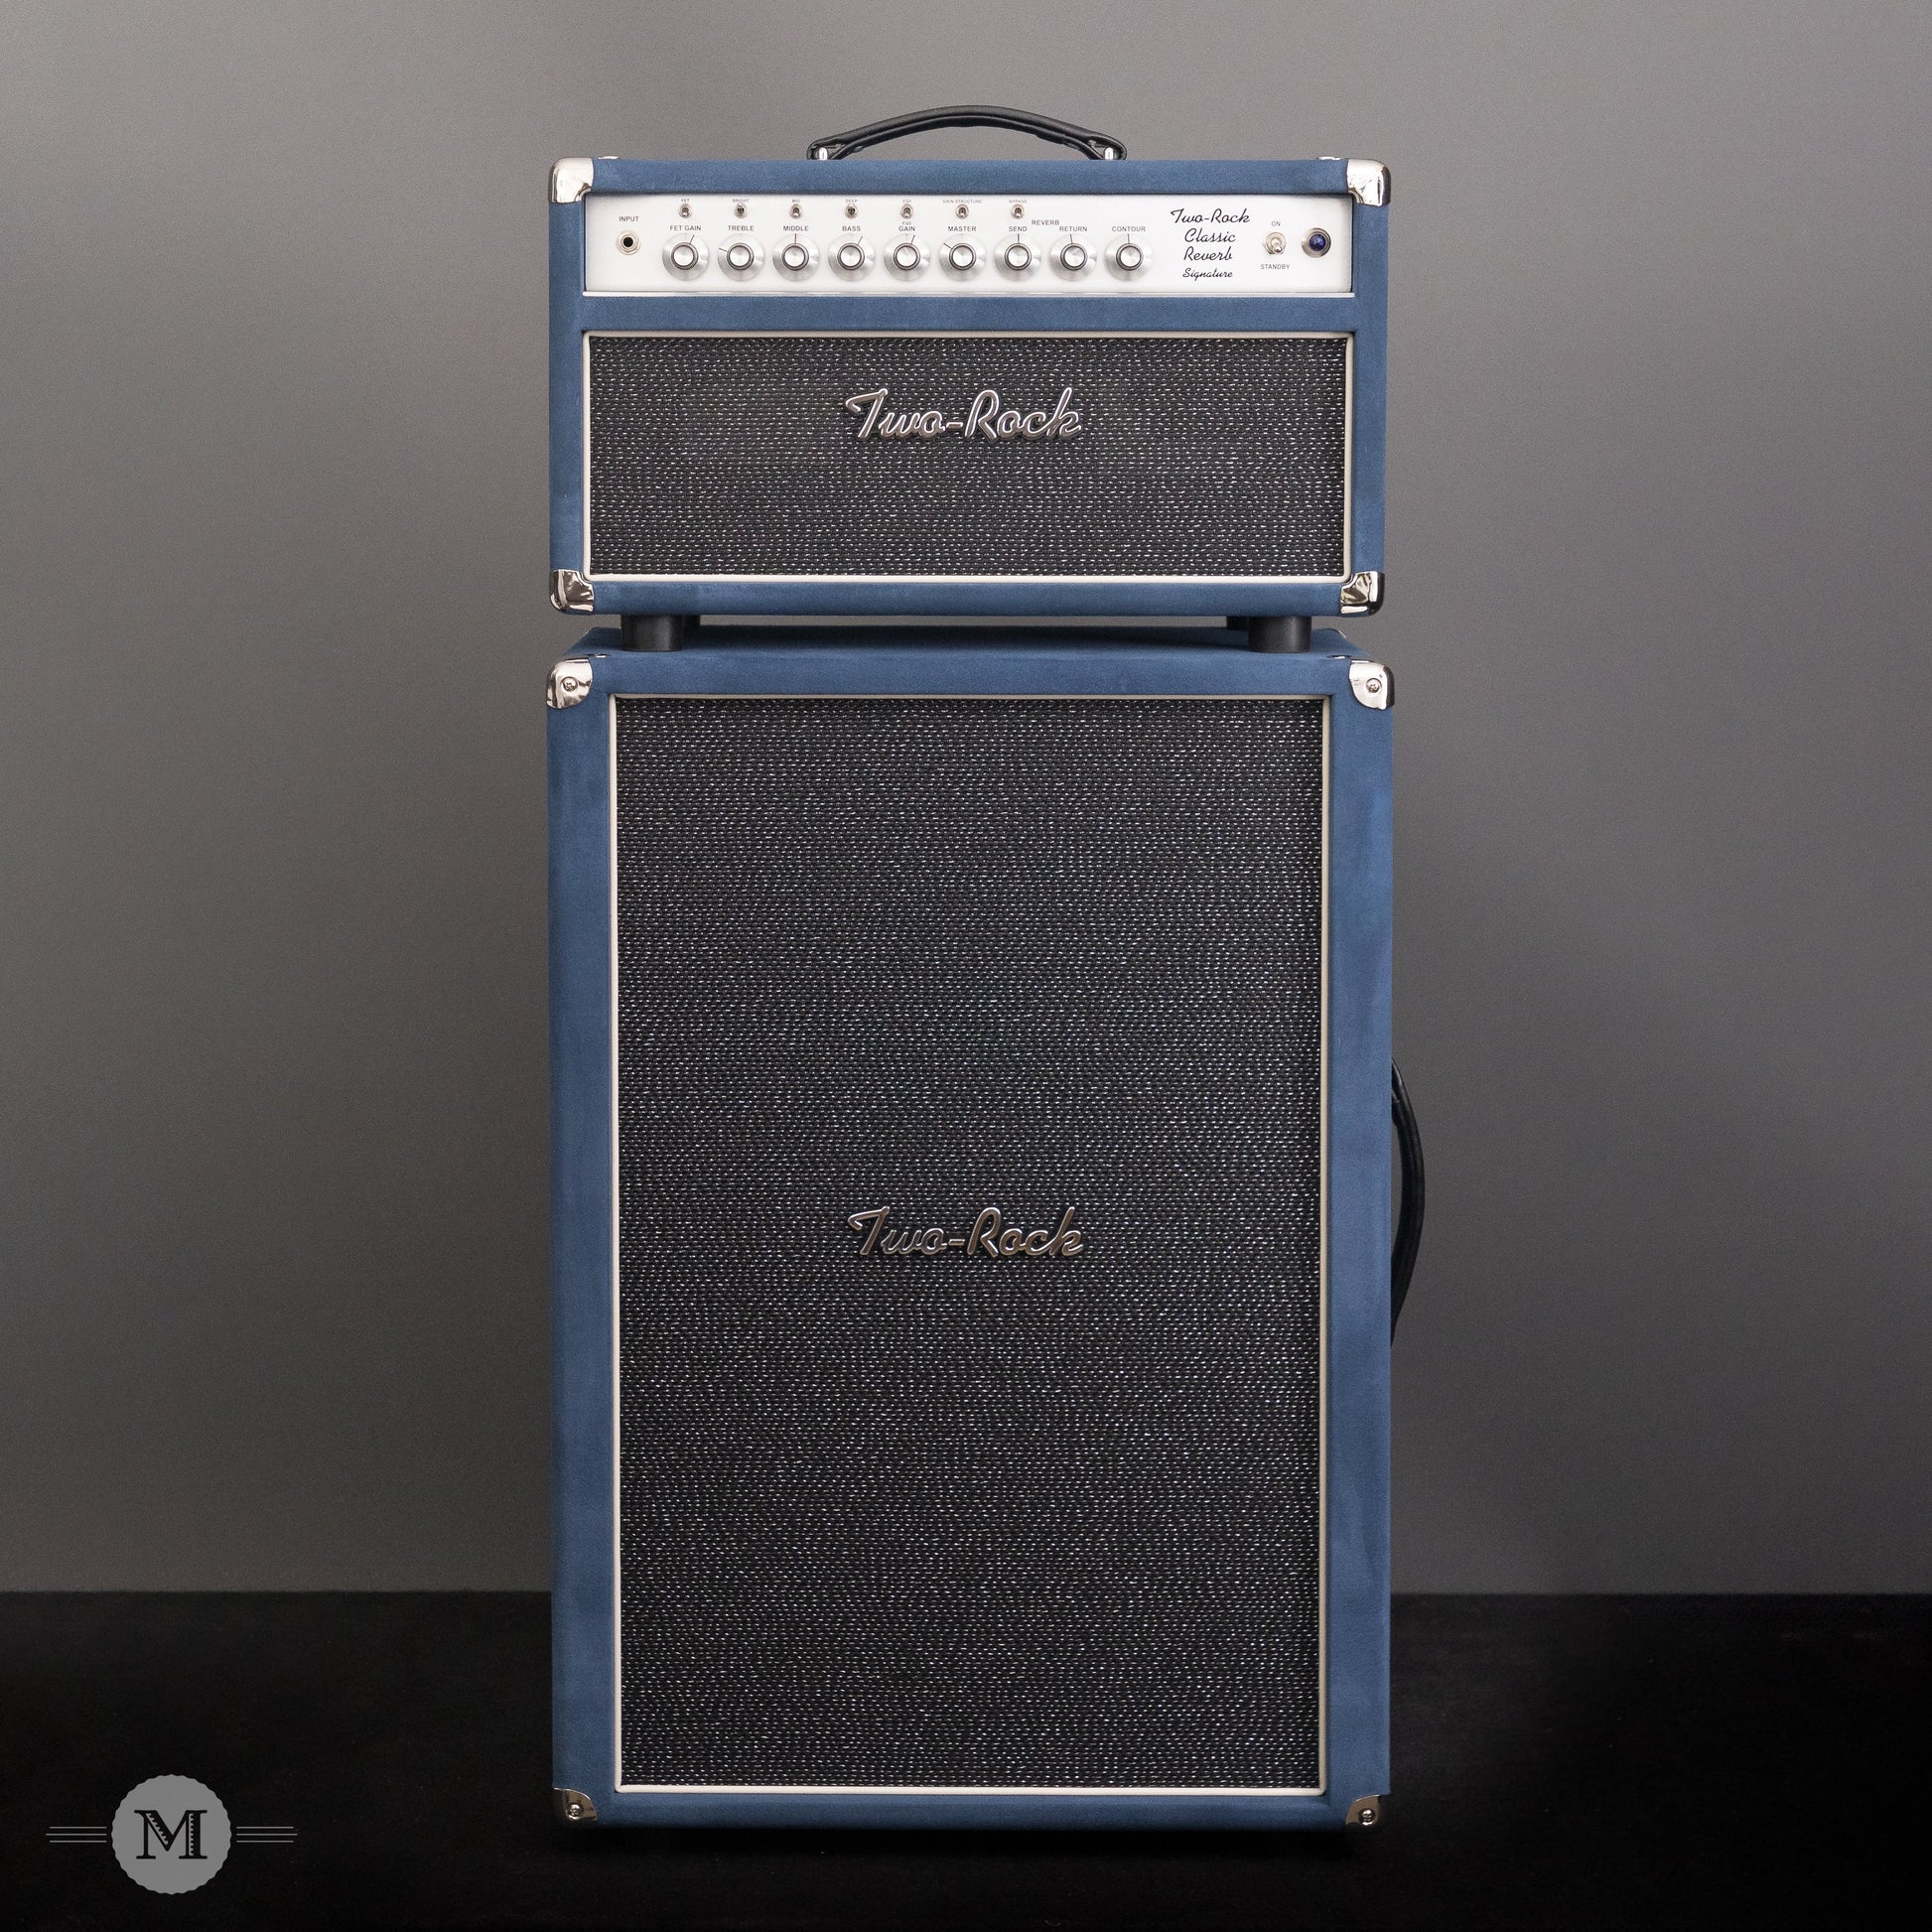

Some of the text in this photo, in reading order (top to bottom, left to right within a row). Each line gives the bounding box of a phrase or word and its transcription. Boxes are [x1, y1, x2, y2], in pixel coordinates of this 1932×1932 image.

[1170, 207, 1251, 223] Two-Rock
[1184, 227, 1236, 243] Classic
[1183, 245, 1233, 261] Reverb
[1182, 267, 1233, 281] Signature
[845, 386, 1083, 442] Two-Rock
[847, 1205, 1085, 1258] Two-Rock
